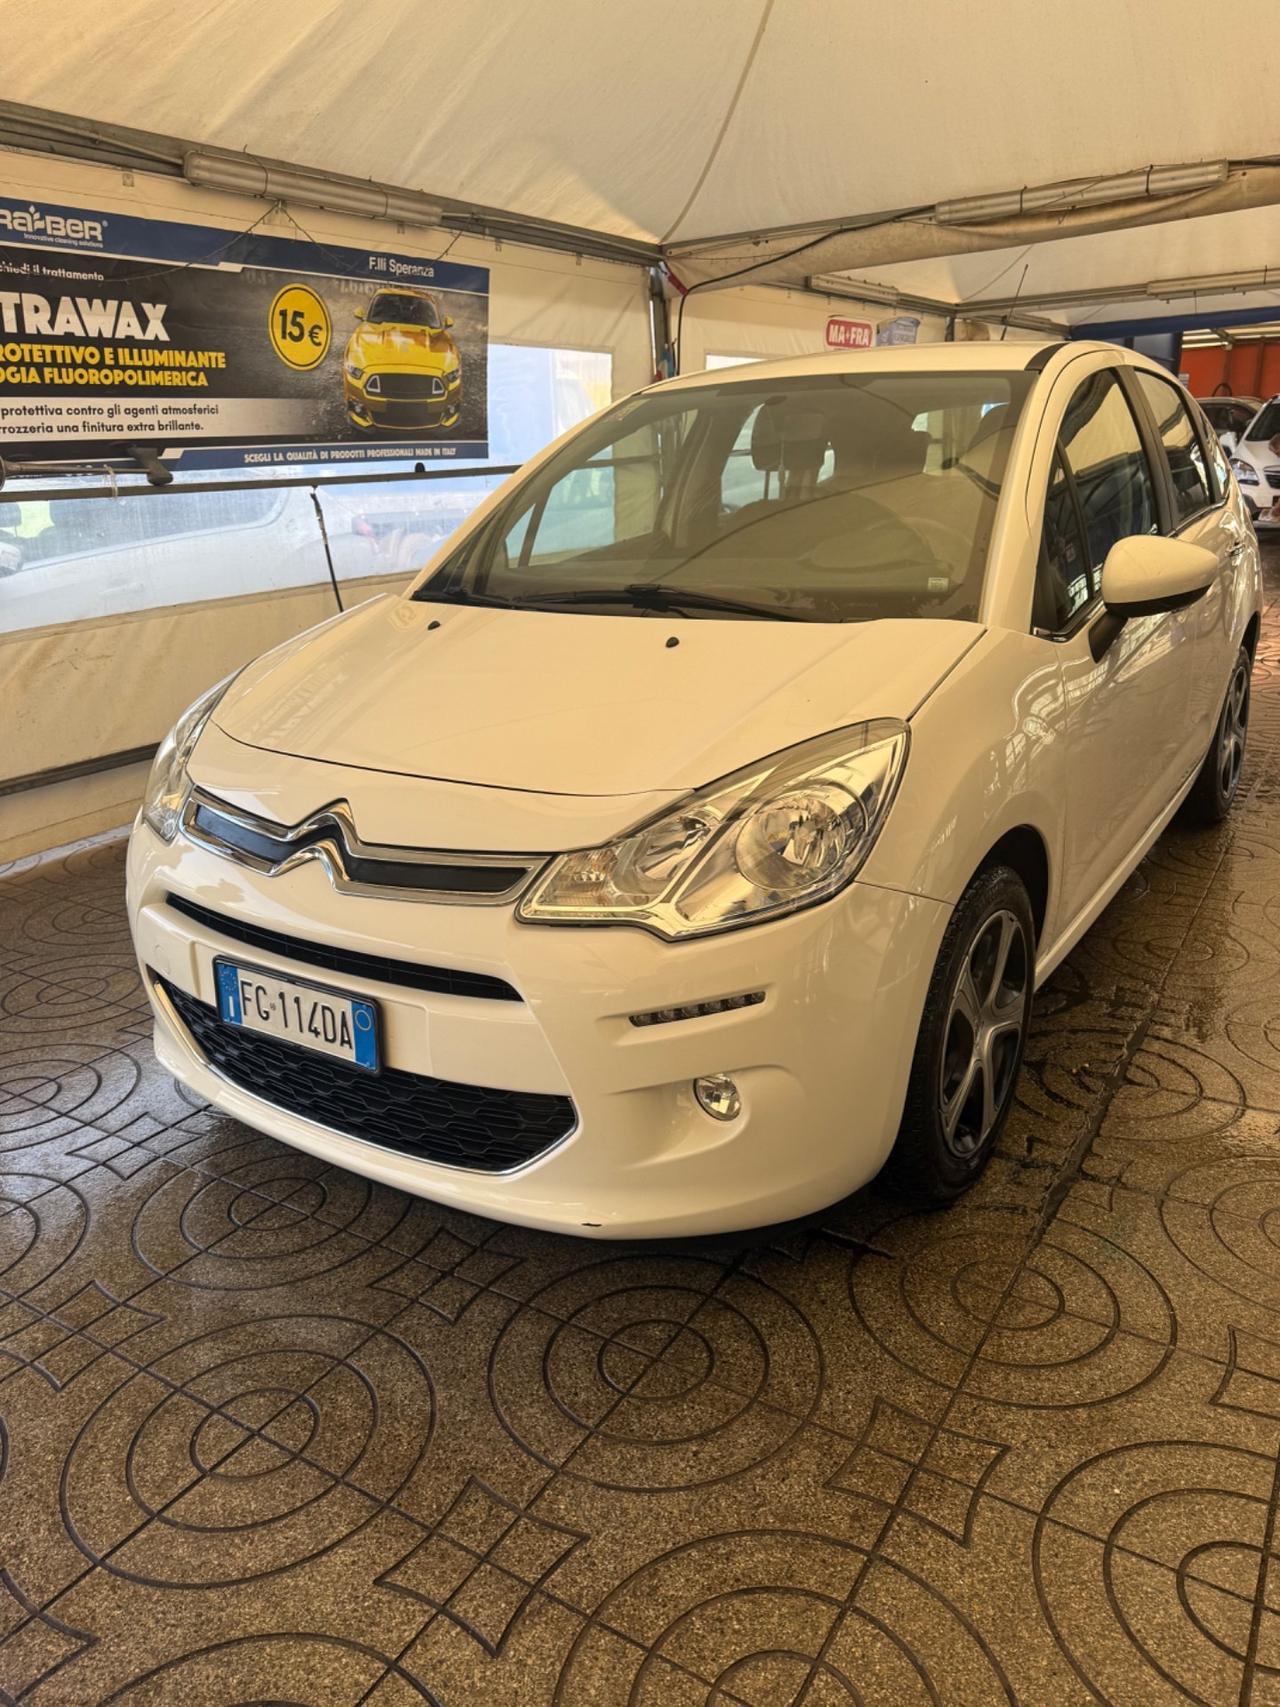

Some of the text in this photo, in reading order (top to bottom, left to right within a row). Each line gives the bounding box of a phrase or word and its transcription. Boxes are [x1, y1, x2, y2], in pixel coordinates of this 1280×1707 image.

[42, 266, 104, 281] trattamento
[388, 258, 435, 278] Speranza
[103, 347, 115, 365] E
[117, 347, 226, 368] ILLUMINANTE
[43, 367, 209, 387] FLUOROPOLIMERICA
[1, 403, 219, 420] protettiva contro gli agenti atmosferici
[56, 425, 80, 433] una
[81, 420, 124, 433] finitura
[126, 421, 155, 432] extra
[157, 419, 204, 432] brillante.
[244, 453, 272, 463] SCEGLI
[273, 453, 284, 461] LA
[320, 450, 329, 460] DI
[330, 449, 365, 460] PRODOTTI
[366, 448, 414, 458] PROFESSIONALI
[415, 447, 432, 457] MADE
[433, 447, 441, 456] IN
